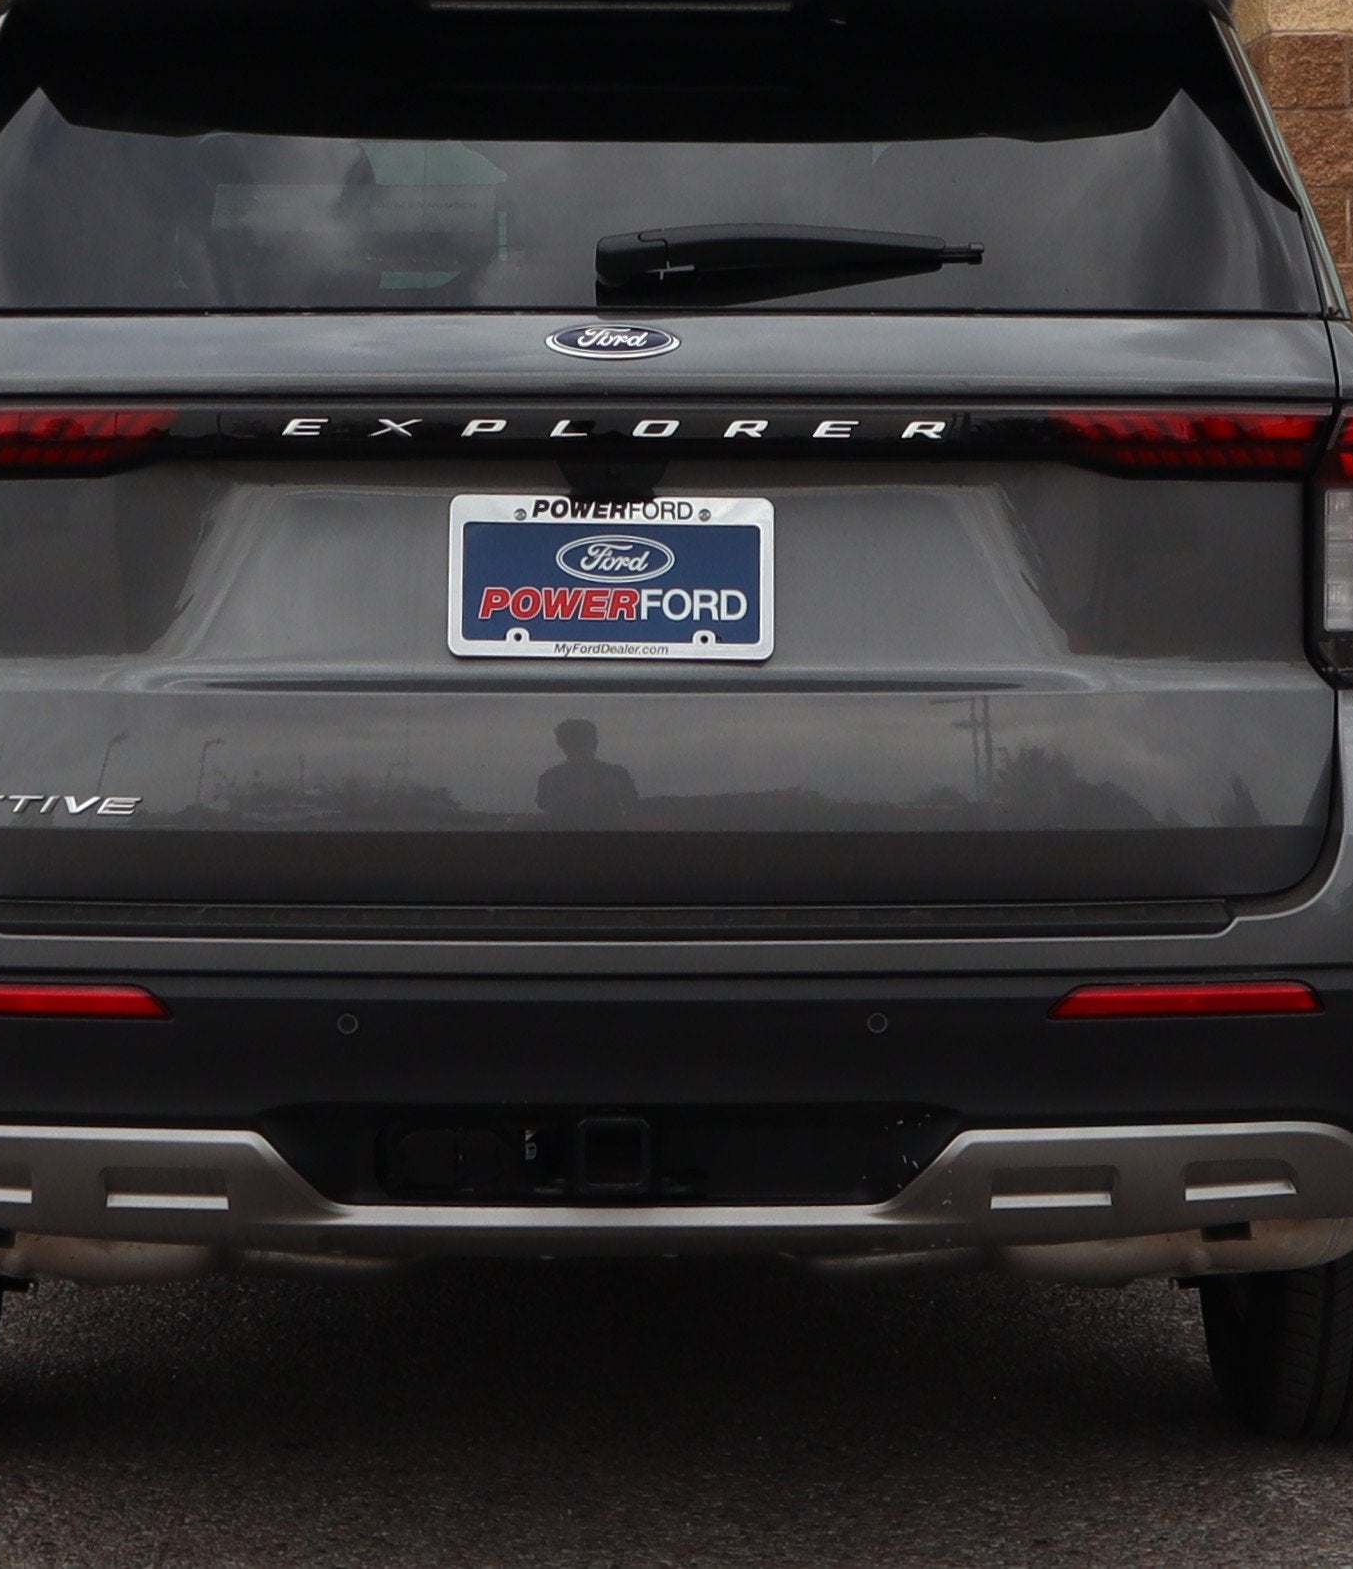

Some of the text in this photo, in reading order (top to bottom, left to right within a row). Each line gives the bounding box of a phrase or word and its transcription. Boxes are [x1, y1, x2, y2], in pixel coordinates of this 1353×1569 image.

[577, 328, 648, 347] Ford
[281, 418, 947, 439] EXPLORER
[580, 543, 650, 573] Ford
[554, 643, 669, 657] MyFordDealer.com
